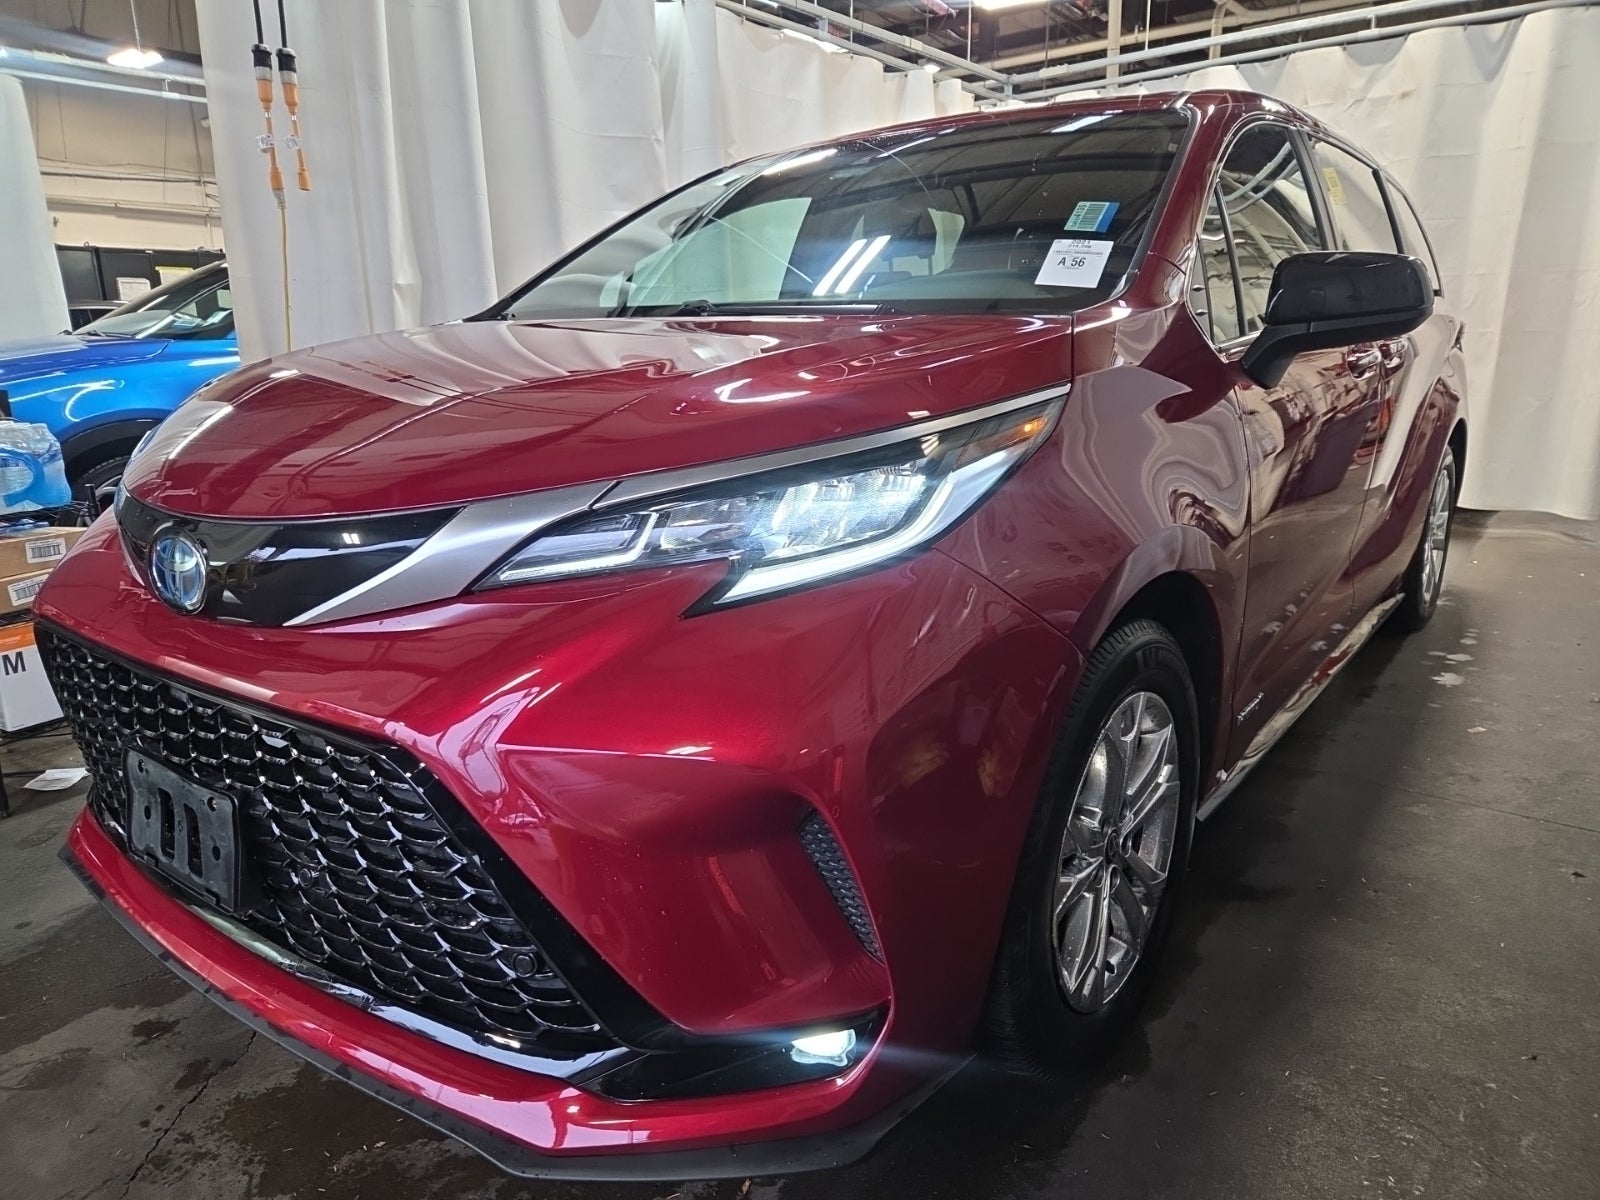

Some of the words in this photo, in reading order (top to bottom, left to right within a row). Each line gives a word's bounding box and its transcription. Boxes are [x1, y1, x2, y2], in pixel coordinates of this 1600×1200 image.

[1057, 256, 1066, 266] A
[1070, 257, 1086, 267] 56
[2, 651, 26, 676] M
